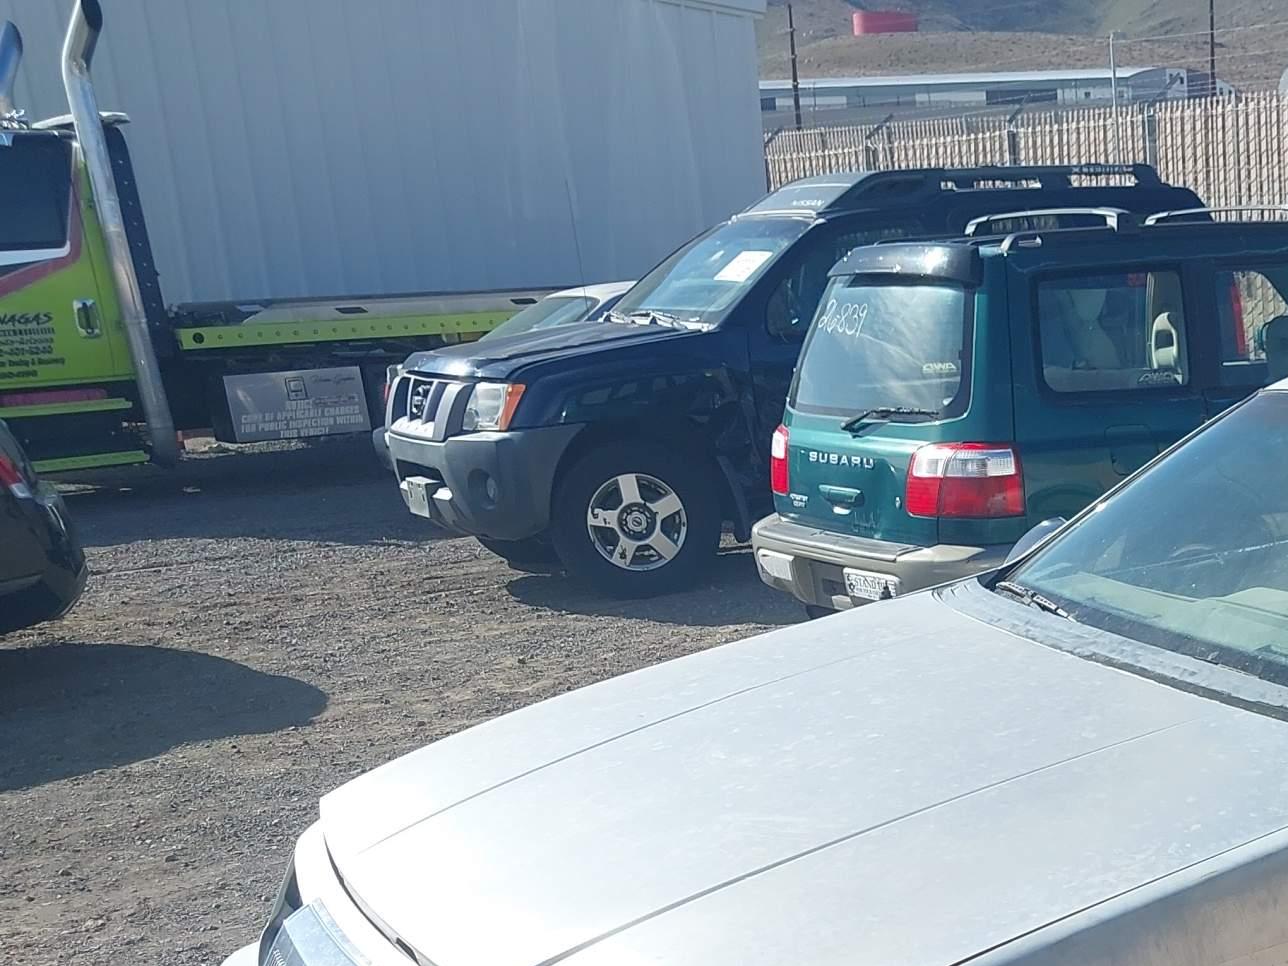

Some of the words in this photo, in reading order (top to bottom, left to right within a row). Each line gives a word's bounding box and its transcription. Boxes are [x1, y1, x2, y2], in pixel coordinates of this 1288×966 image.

[259, 421, 288, 432] PUBLIC
[289, 417, 334, 431] INSPECTION
[336, 414, 364, 425] WITHIN
[280, 430, 298, 438] THIS
[300, 427, 329, 437] VEHICLE
[808, 451, 875, 470] SUBARU
